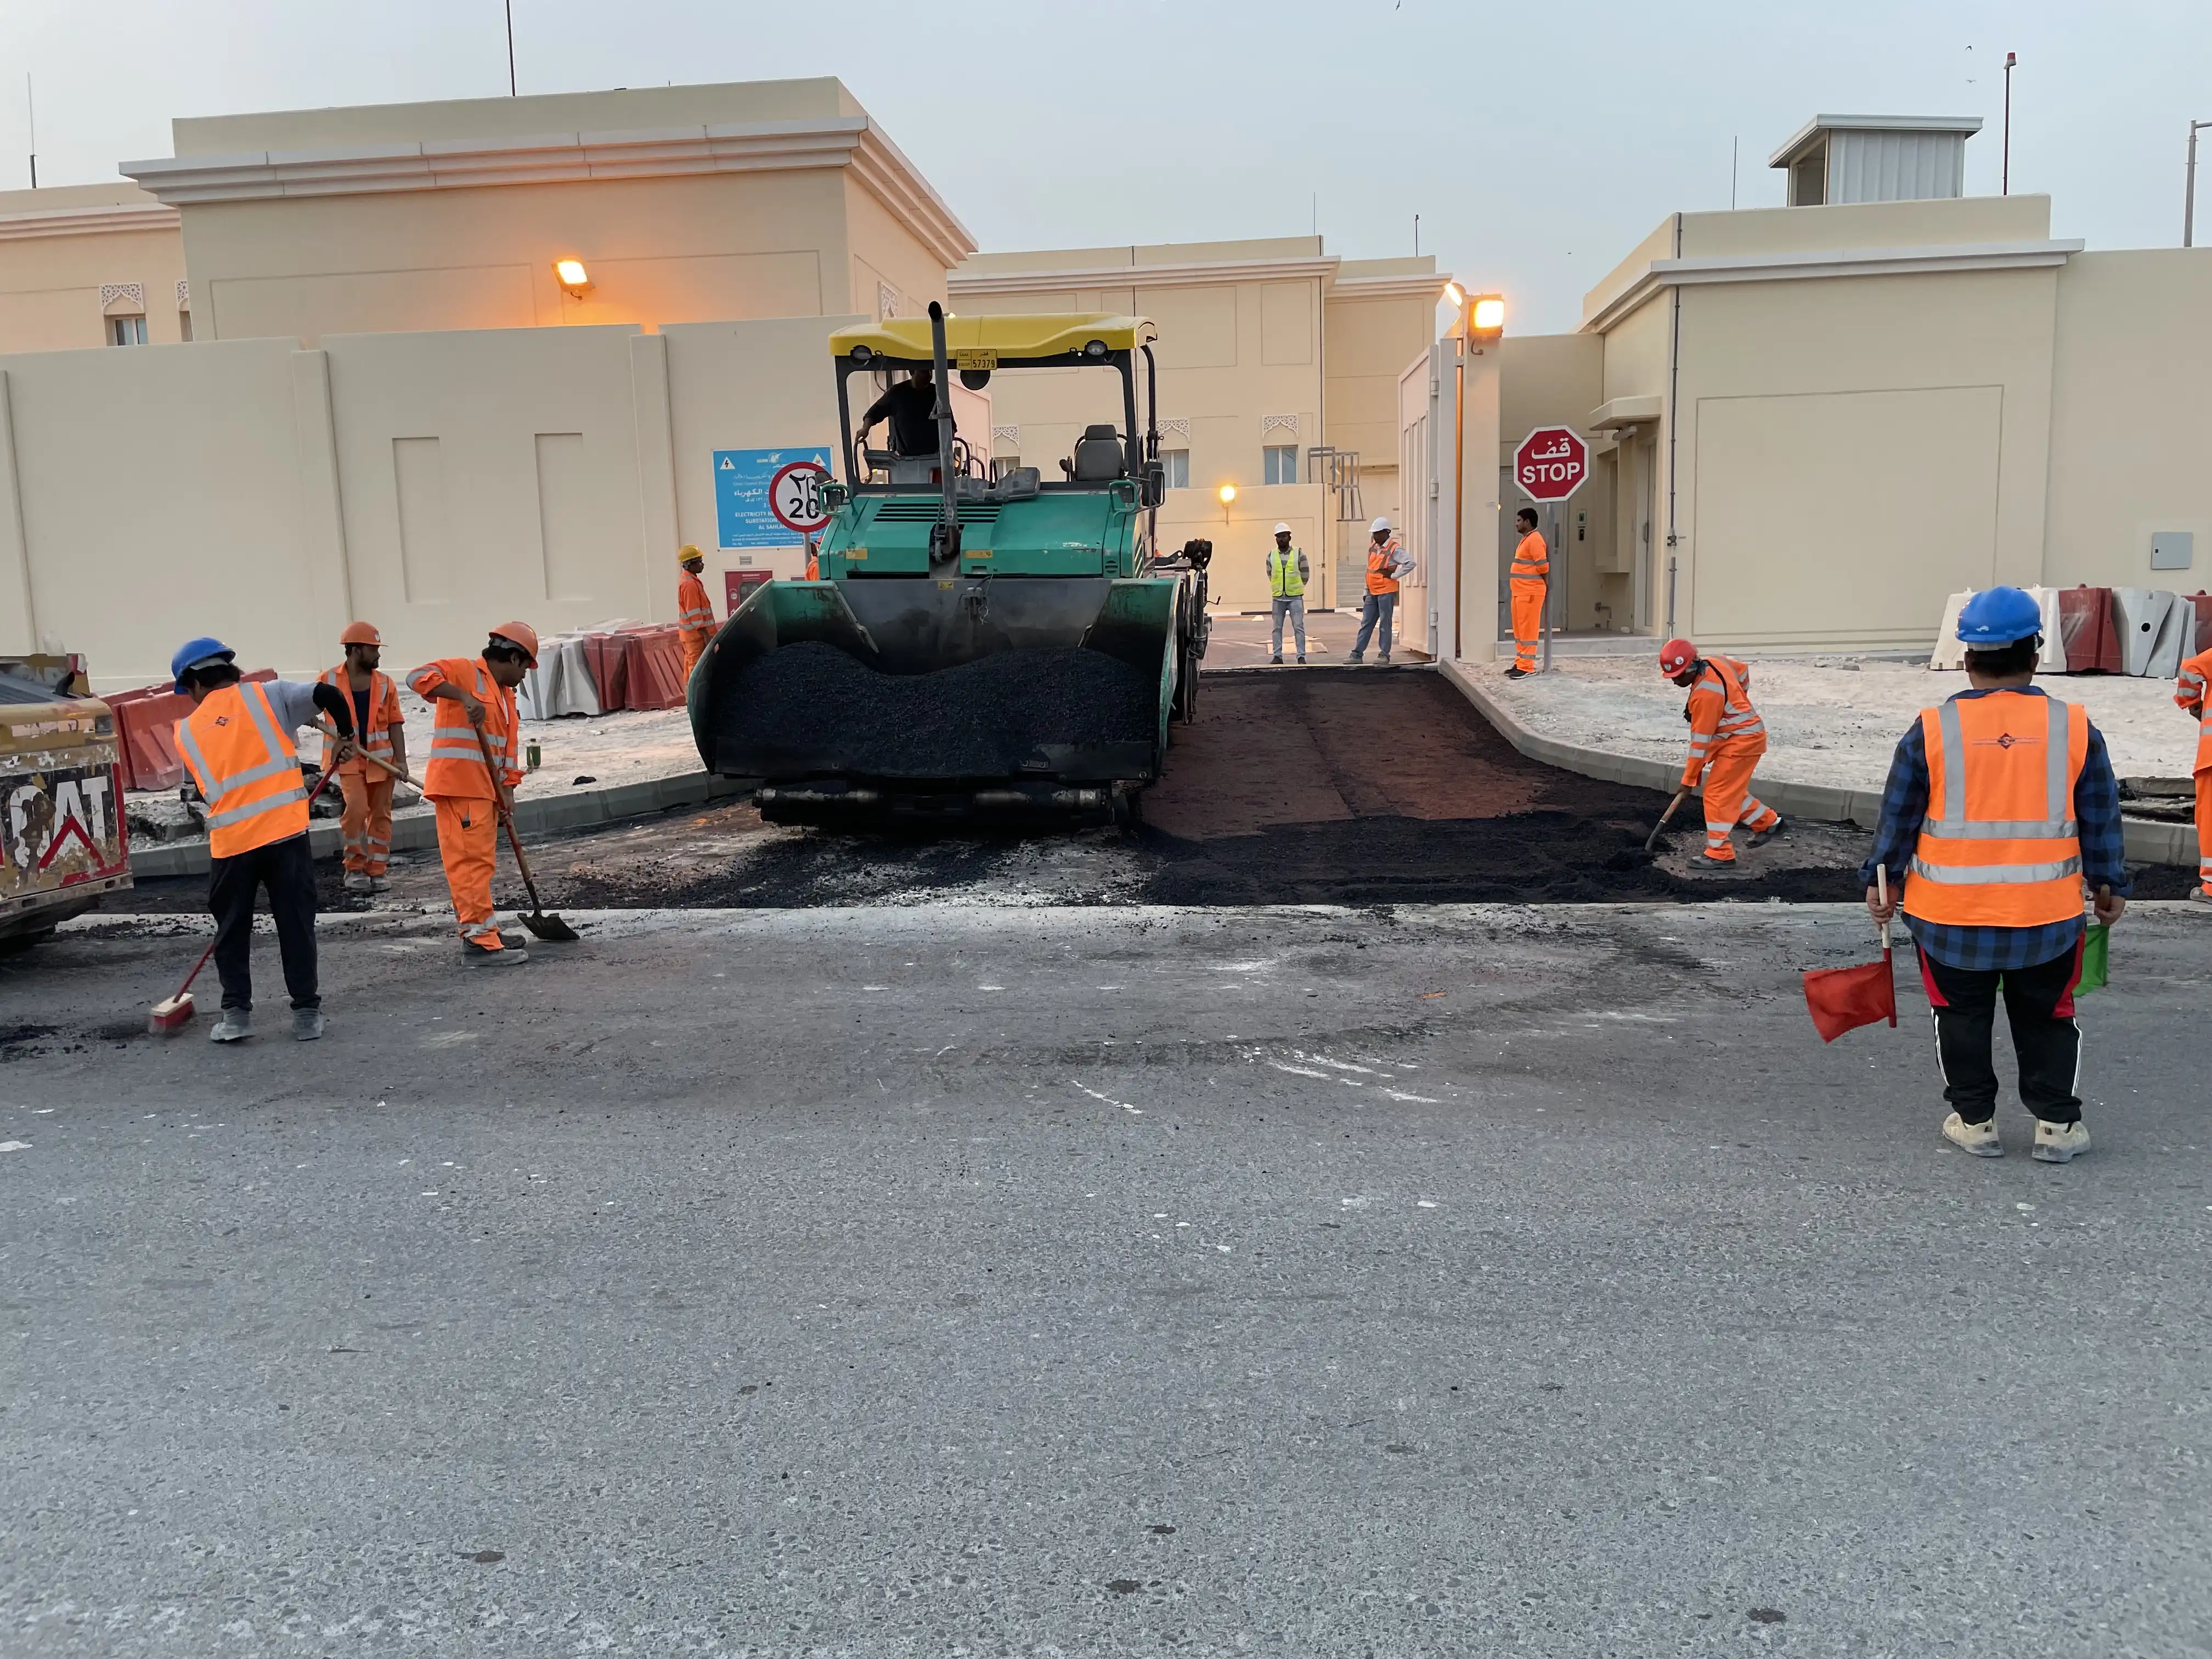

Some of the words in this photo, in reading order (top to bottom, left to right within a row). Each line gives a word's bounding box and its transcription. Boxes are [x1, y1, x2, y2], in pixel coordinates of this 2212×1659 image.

[973, 359, 995, 368] 57379
[1532, 437, 1571, 460] قف
[1522, 461, 1581, 484] STOP
[789, 498, 820, 519] 20
[10, 776, 109, 868] CAT
